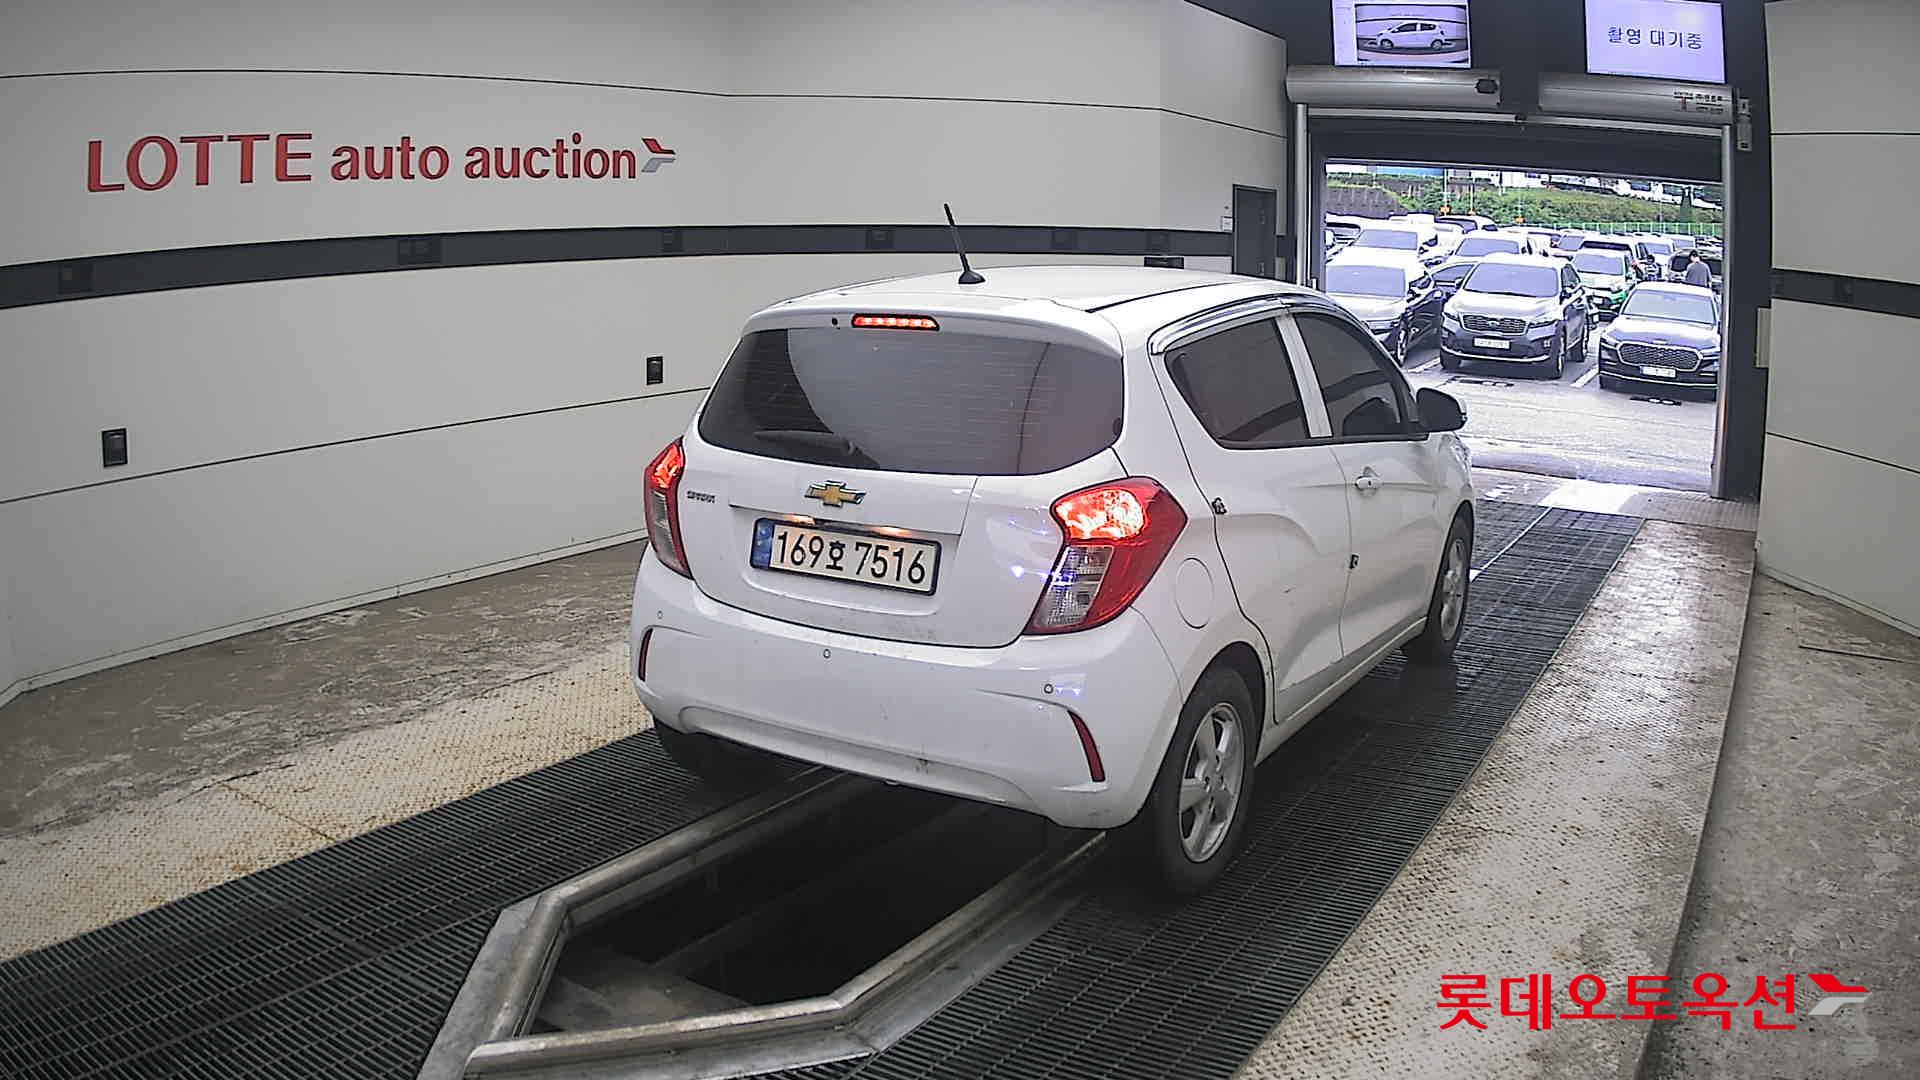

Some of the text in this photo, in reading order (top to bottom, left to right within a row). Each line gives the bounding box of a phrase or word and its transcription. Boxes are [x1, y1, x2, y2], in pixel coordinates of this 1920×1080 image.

[1648, 30, 1702, 50] 대기중
[87, 132, 638, 193] LOTTE auto auction
[777, 531, 926, 585] 169호 7516
